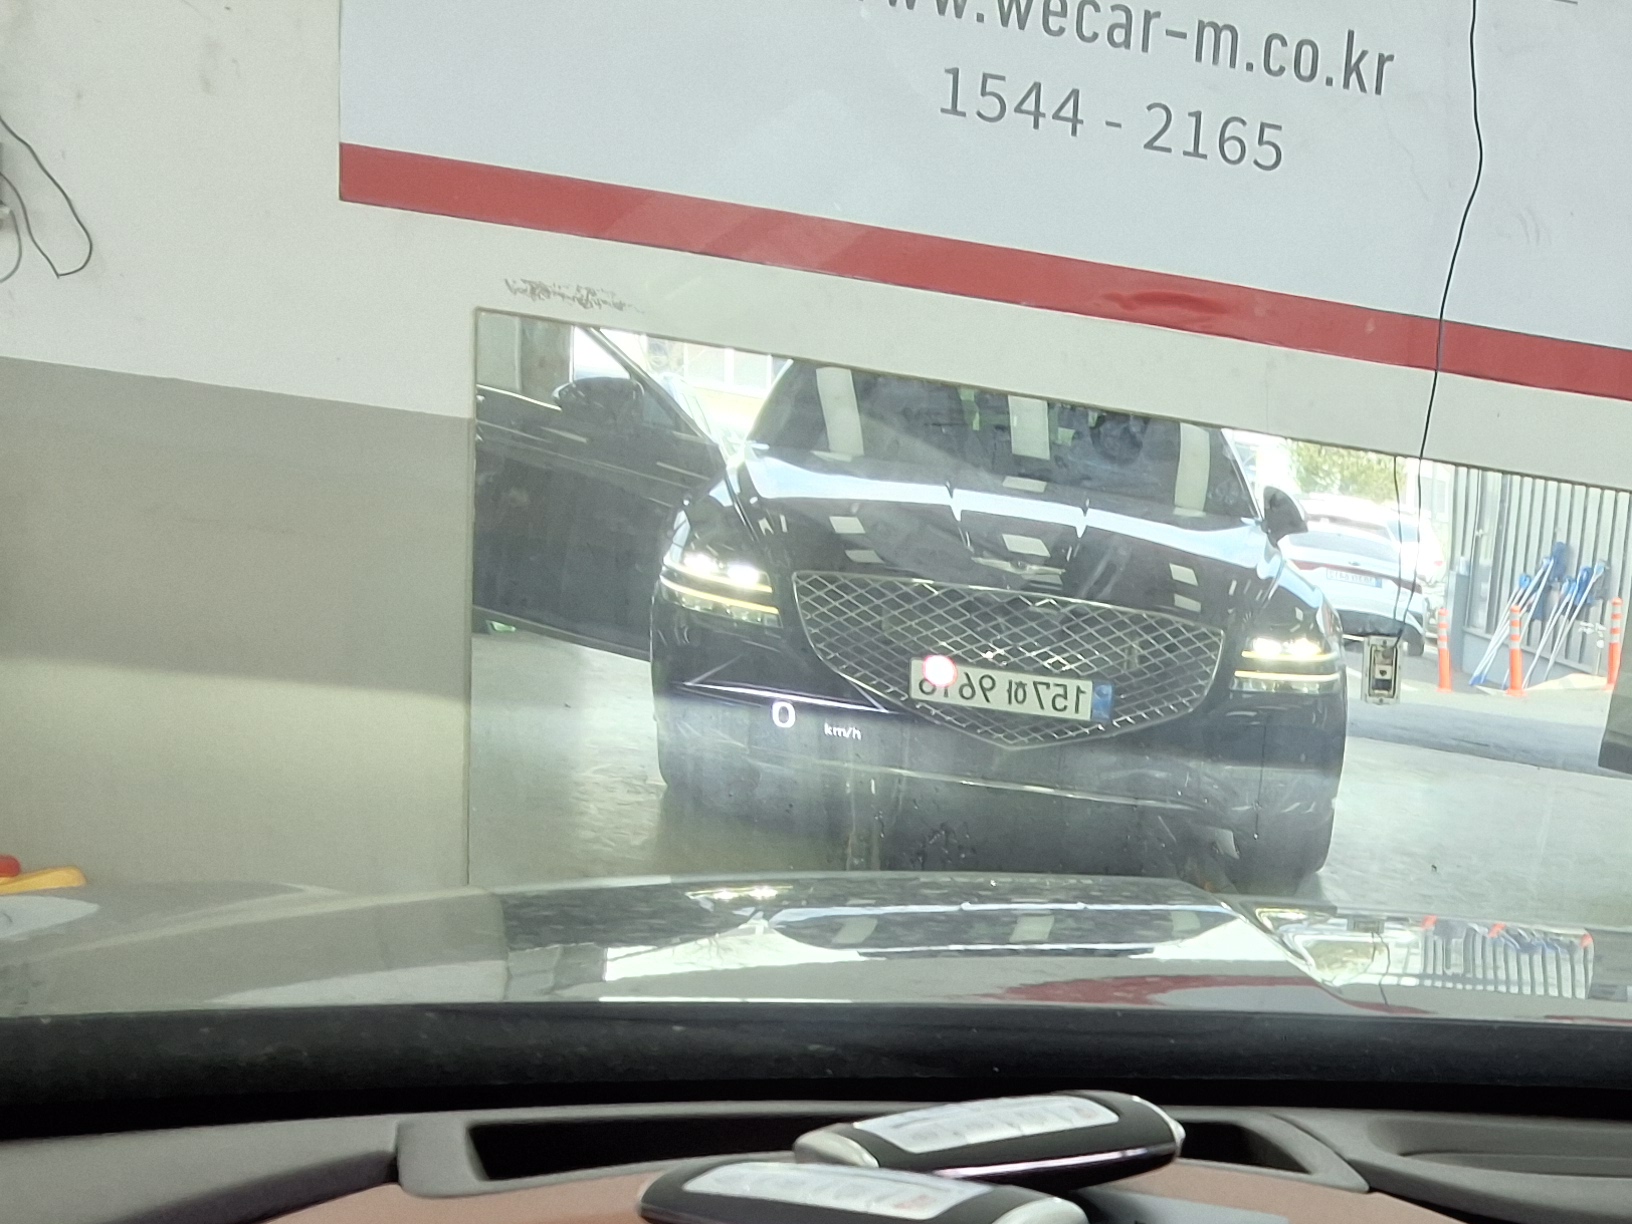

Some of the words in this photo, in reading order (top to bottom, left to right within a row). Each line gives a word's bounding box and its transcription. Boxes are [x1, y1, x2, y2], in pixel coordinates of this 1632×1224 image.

[939, 66, 1084, 138] 1544
[1143, 102, 1285, 171] 2165
[771, 701, 796, 728] 0
[823, 721, 862, 740] km/h
